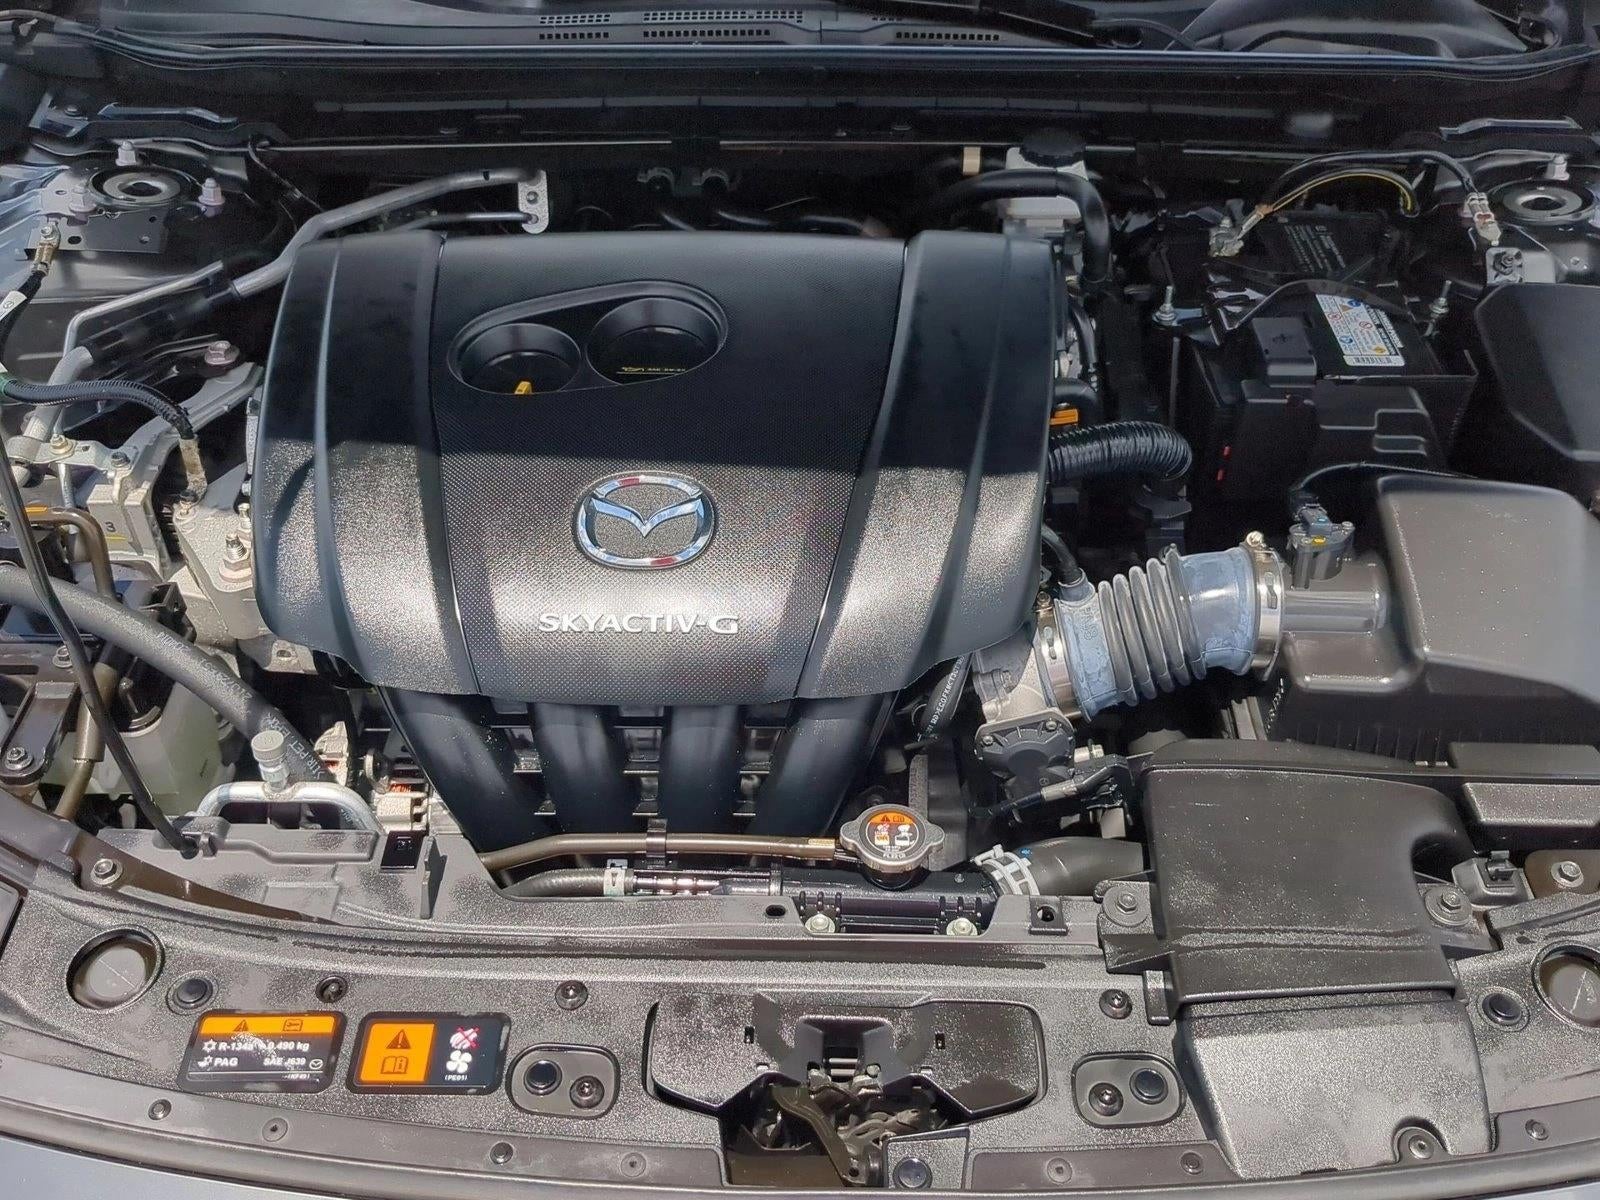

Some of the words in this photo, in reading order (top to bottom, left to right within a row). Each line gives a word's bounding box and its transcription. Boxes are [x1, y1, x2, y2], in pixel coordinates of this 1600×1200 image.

[538, 612, 738, 635] SKYACTIV-G
[296, 1041, 309, 1052] kg
[213, 1057, 239, 1067] PAG
[263, 1056, 283, 1067] SAE
